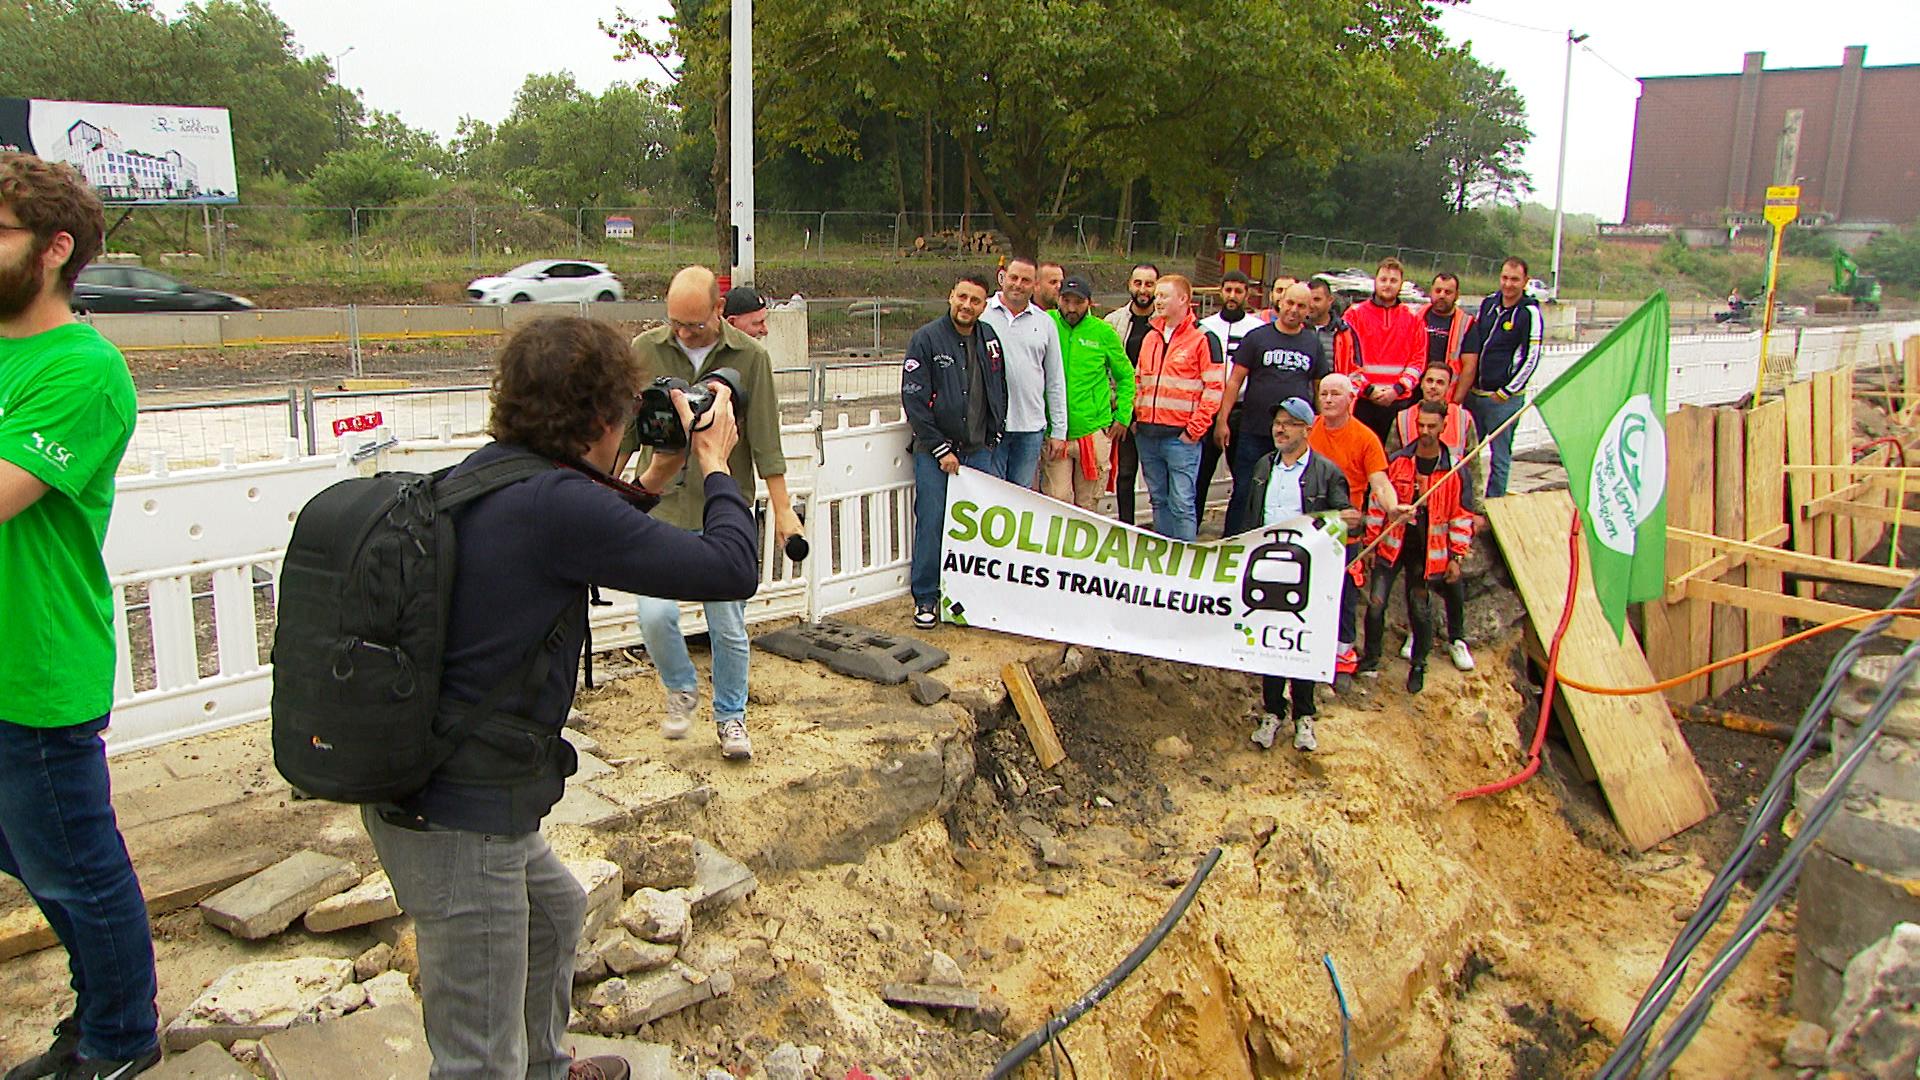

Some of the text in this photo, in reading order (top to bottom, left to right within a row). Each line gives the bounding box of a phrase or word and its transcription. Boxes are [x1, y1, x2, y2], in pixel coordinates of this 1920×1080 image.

[1007, 563, 1050, 588] LES
[1056, 570, 1232, 616] TRAVAILLEURS
[1262, 625, 1313, 653] CSC
